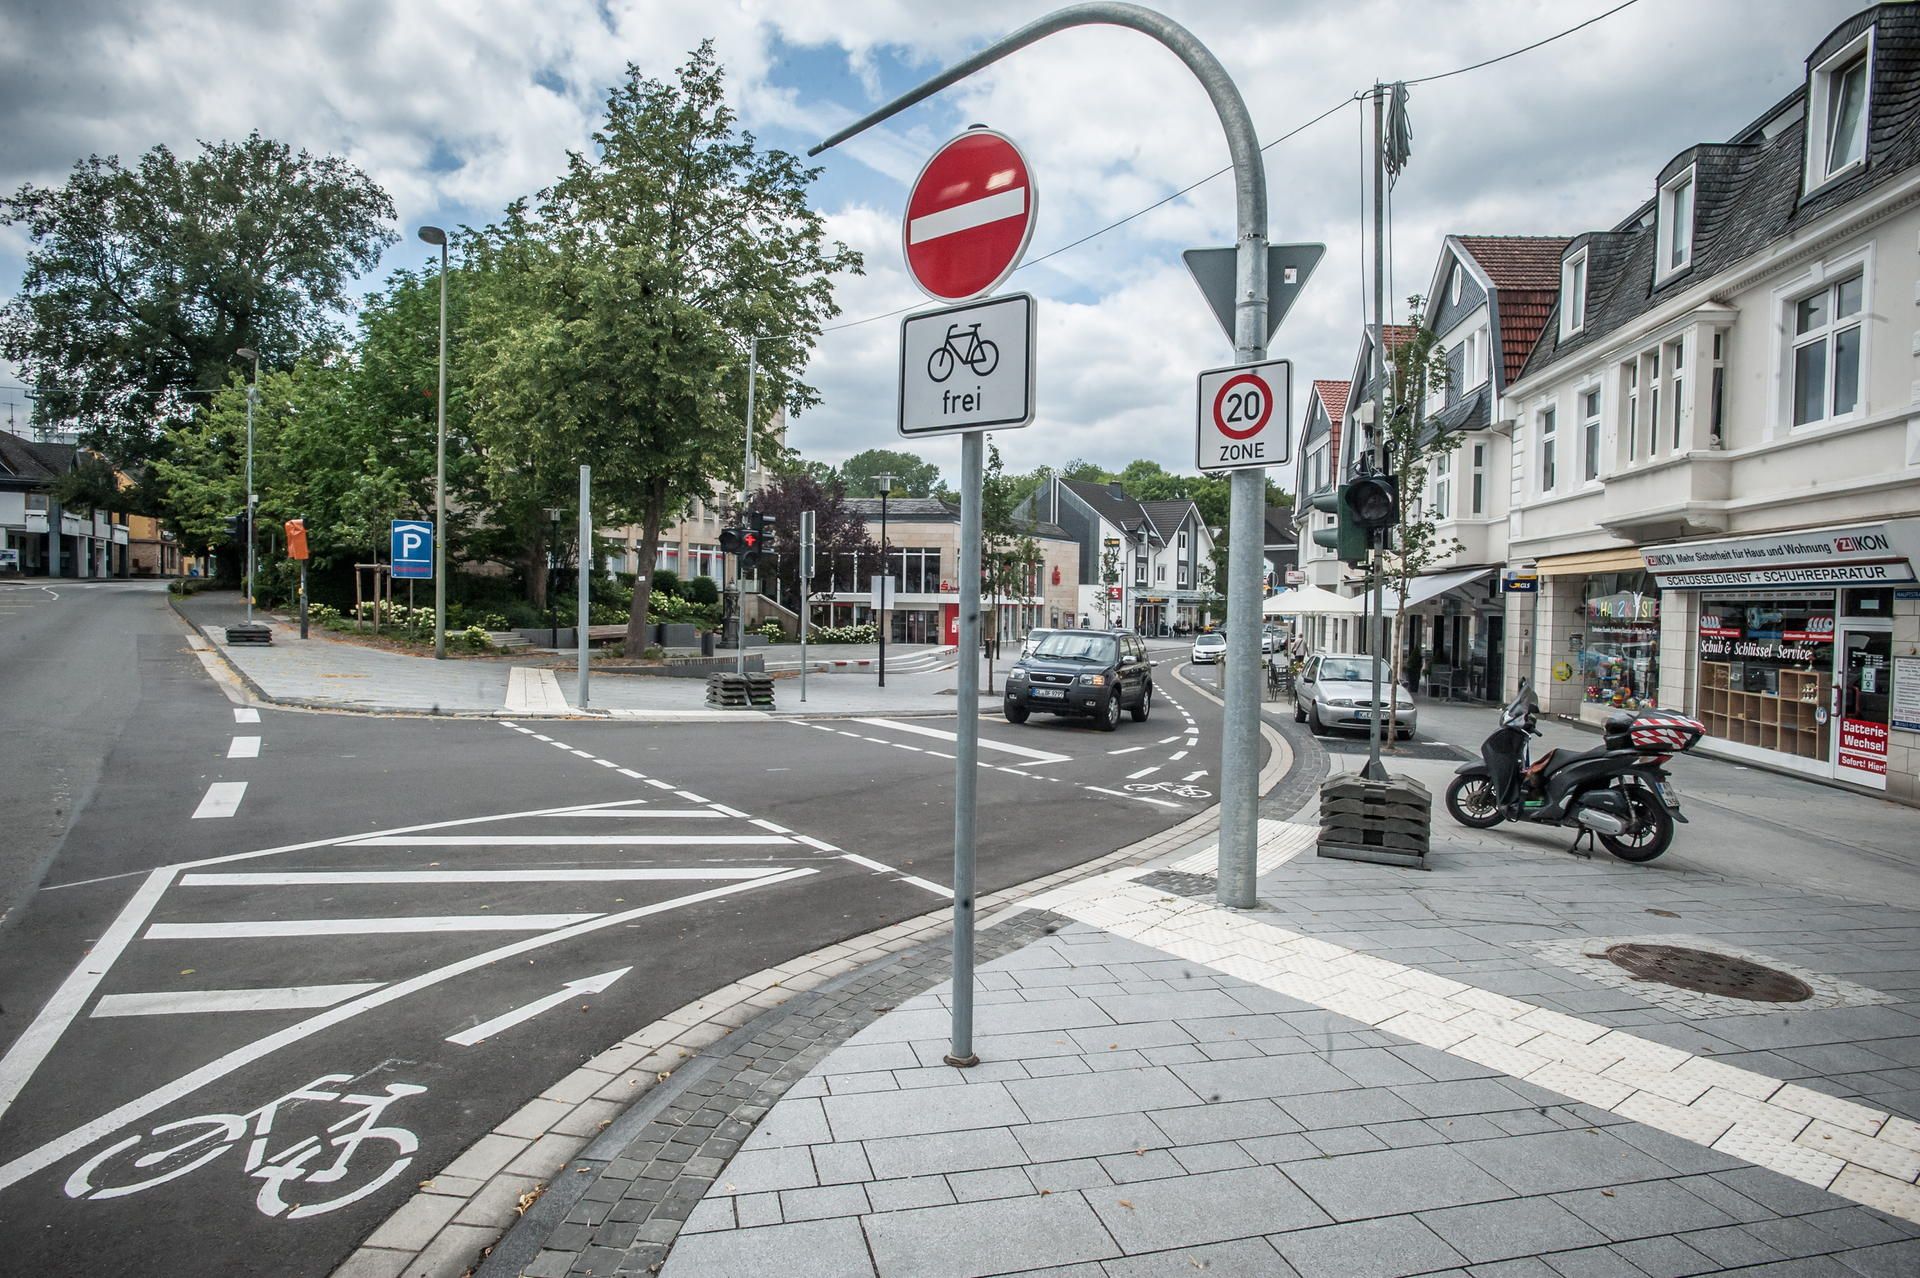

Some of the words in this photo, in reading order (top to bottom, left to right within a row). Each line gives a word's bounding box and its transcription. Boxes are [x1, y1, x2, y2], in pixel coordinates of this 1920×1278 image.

[943, 386, 981, 414] frei
[1226, 391, 1260, 423] 20
[1220, 442, 1265, 461] ZONE
[403, 533, 422, 558] P
[1676, 554, 1695, 563] Mehr
[1695, 550, 1731, 562] Sicherheit
[1731, 549, 1744, 559] für
[1744, 548, 1766, 558] Haus
[1766, 545, 1785, 557] und
[1784, 543, 1832, 555] Wohnung
[1666, 573, 1752, 586] SCHLÜSSELDIENST
[1763, 567, 1887, 582] SCHUHREPARATUR
[1724, 642, 1732, 655] &
[1734, 642, 1773, 658] Schlüssel
[1776, 644, 1812, 660] Service
[1843, 721, 1887, 737] Batterie-
[1844, 734, 1884, 751] Wechsel
[1842, 756, 1865, 767] Sofort!
[1867, 761, 1885, 772] Hier!
